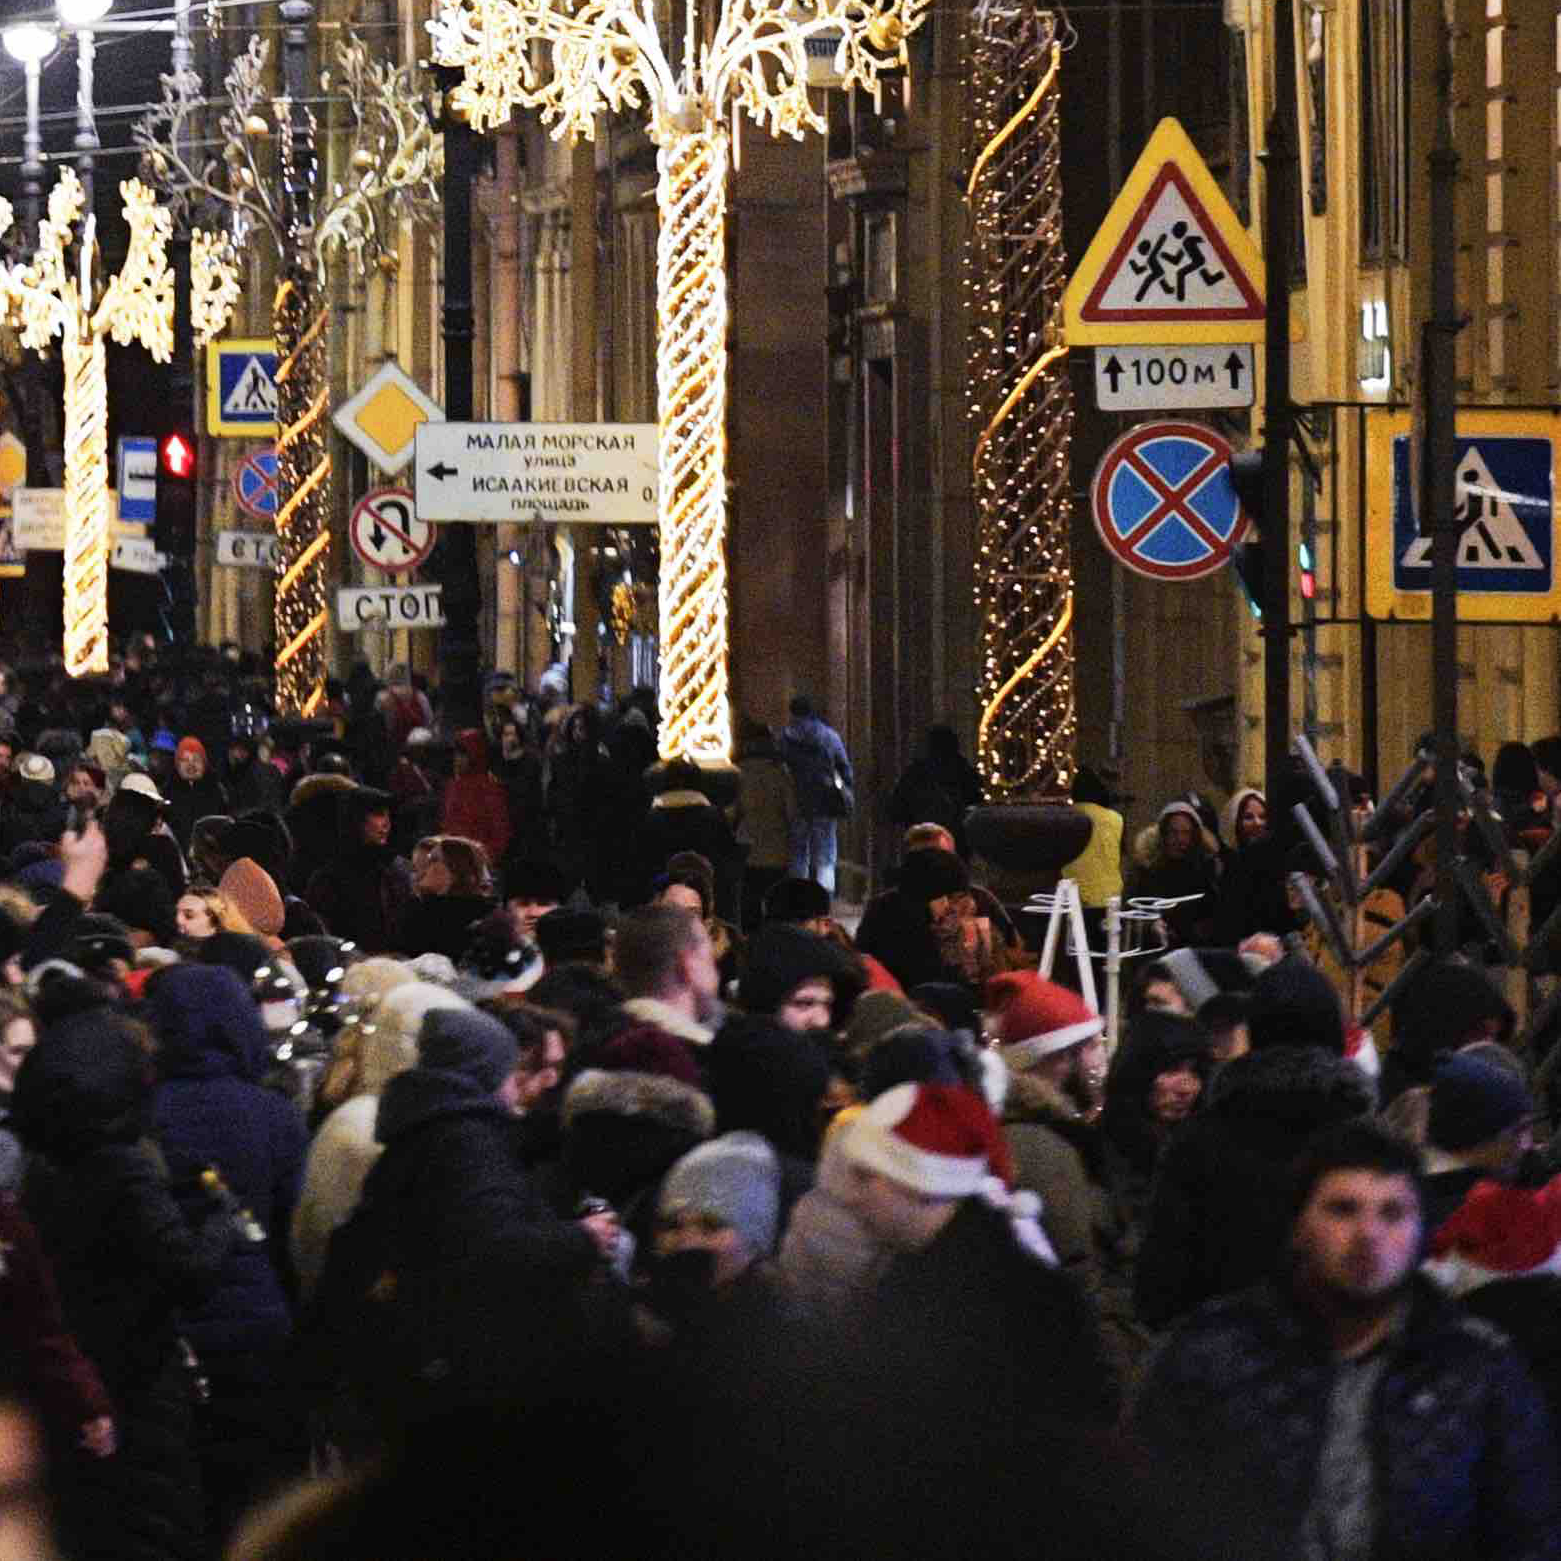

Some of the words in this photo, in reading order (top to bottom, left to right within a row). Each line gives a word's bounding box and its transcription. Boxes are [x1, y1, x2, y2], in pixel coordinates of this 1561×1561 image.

[466, 434, 535, 450] МАЛАЯ
[541, 434, 636, 451] МОРСКАЯ
[523, 454, 577, 468] улица
[471, 476, 630, 494] ИСААКИЕВСКАЯ
[510, 497, 590, 512] площадь
[355, 592, 446, 623] СТОП
